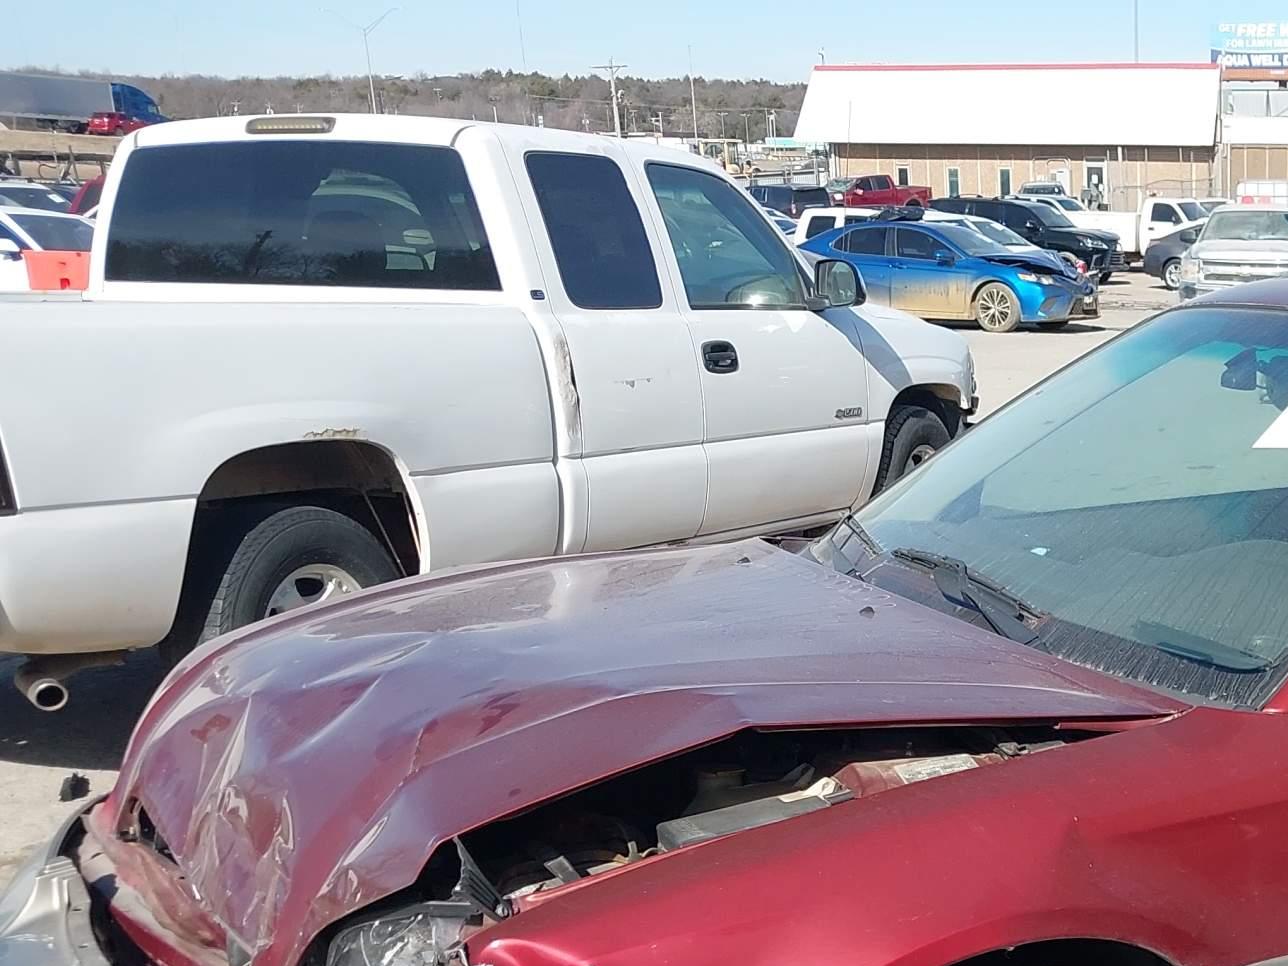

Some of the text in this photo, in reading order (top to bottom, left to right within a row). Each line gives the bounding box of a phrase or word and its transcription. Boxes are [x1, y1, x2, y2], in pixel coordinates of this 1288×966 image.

[1219, 24, 1236, 32] GET
[1237, 23, 1278, 37] FREE
[1217, 54, 1250, 66] AQUA
[1251, 54, 1282, 66] WELL
